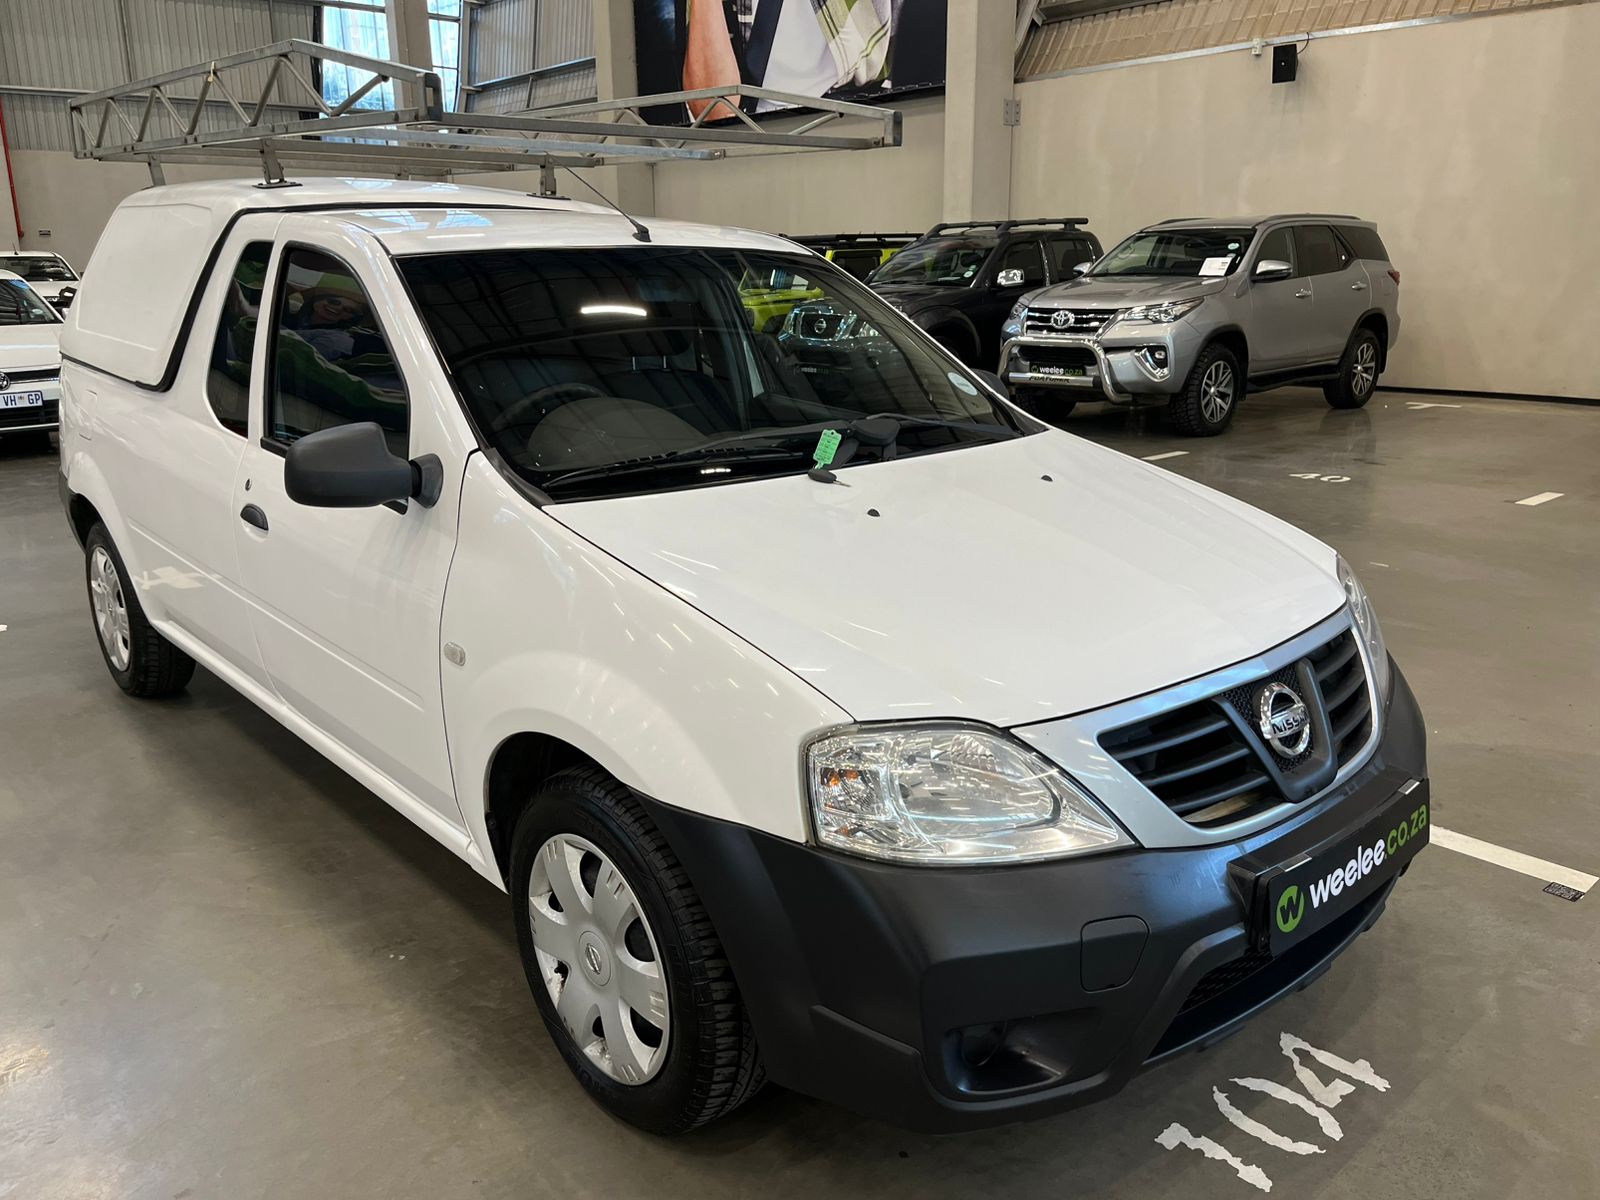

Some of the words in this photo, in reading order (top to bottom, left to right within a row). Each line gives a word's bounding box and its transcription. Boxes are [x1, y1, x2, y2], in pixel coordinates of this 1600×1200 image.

[3, 395, 17, 407] VH
[28, 393, 41, 405] GP
[1309, 804, 1427, 909] weelee.co.za
[1154, 1031, 1391, 1192] 104
